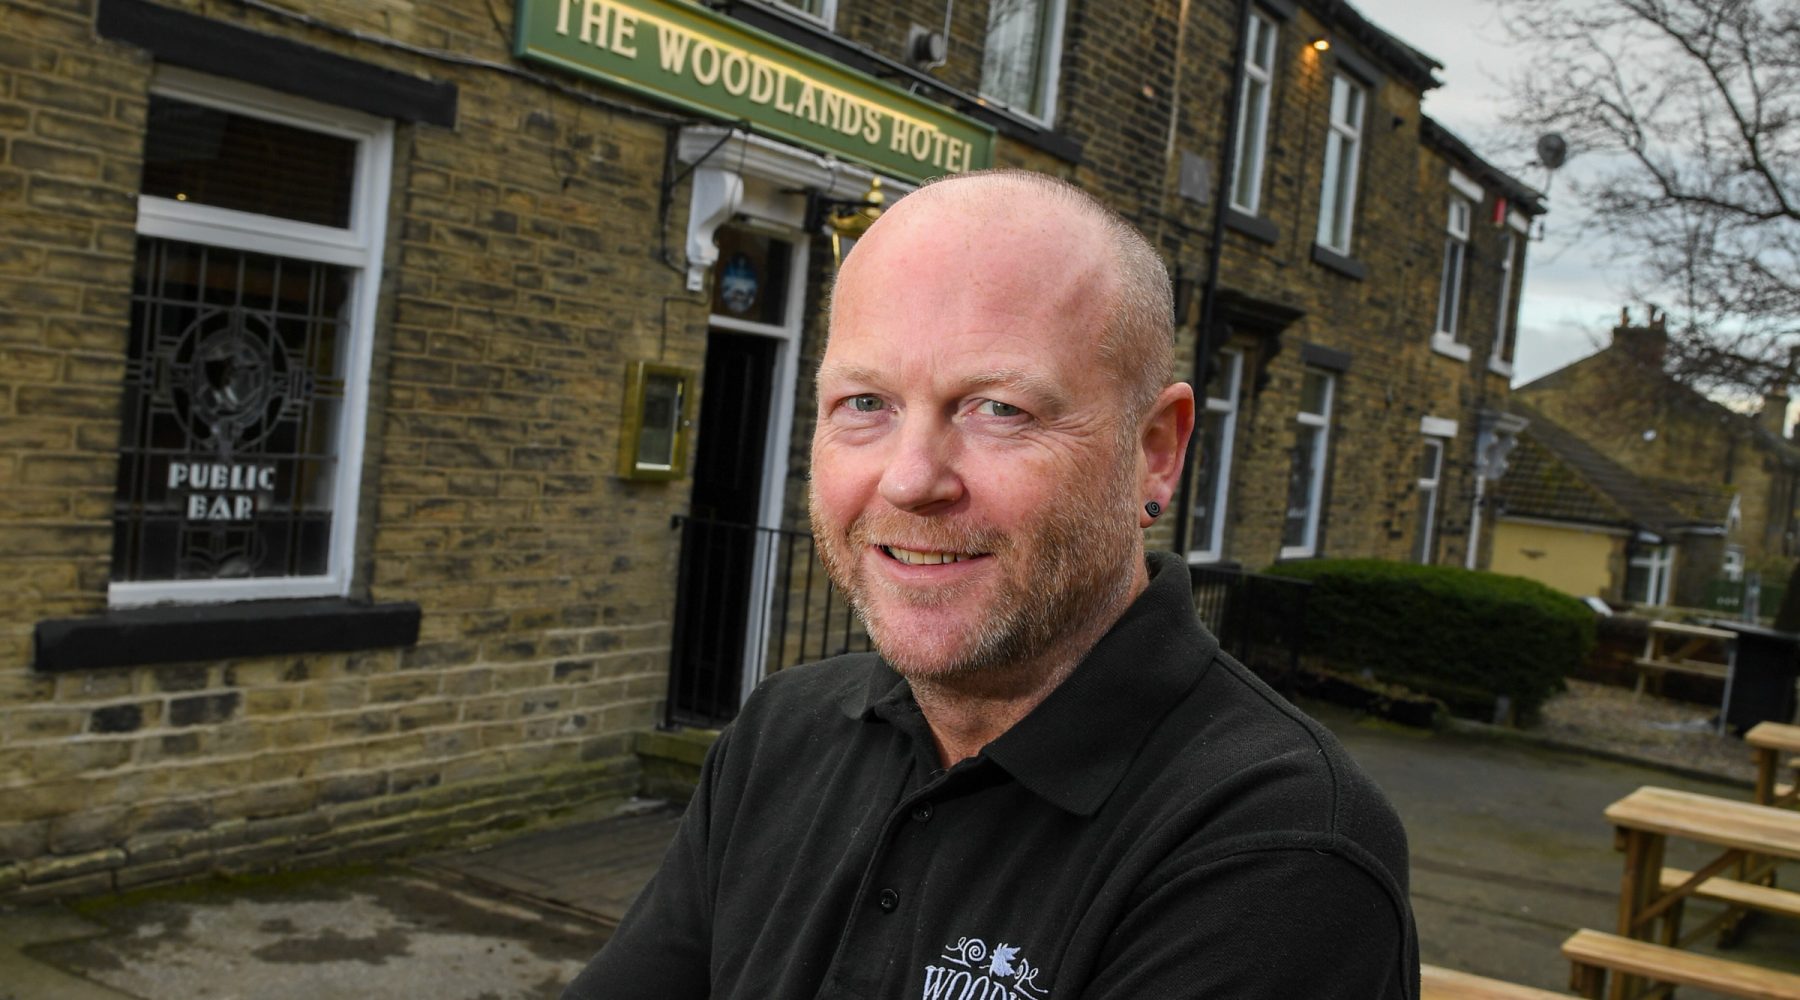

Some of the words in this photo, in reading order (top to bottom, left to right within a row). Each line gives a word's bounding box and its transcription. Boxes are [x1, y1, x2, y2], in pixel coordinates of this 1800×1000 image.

[556, 0, 638, 58] THE
[657, 25, 882, 143] WOODLANDS
[168, 463, 275, 490] PUBLIC
[187, 495, 253, 520] BAR
